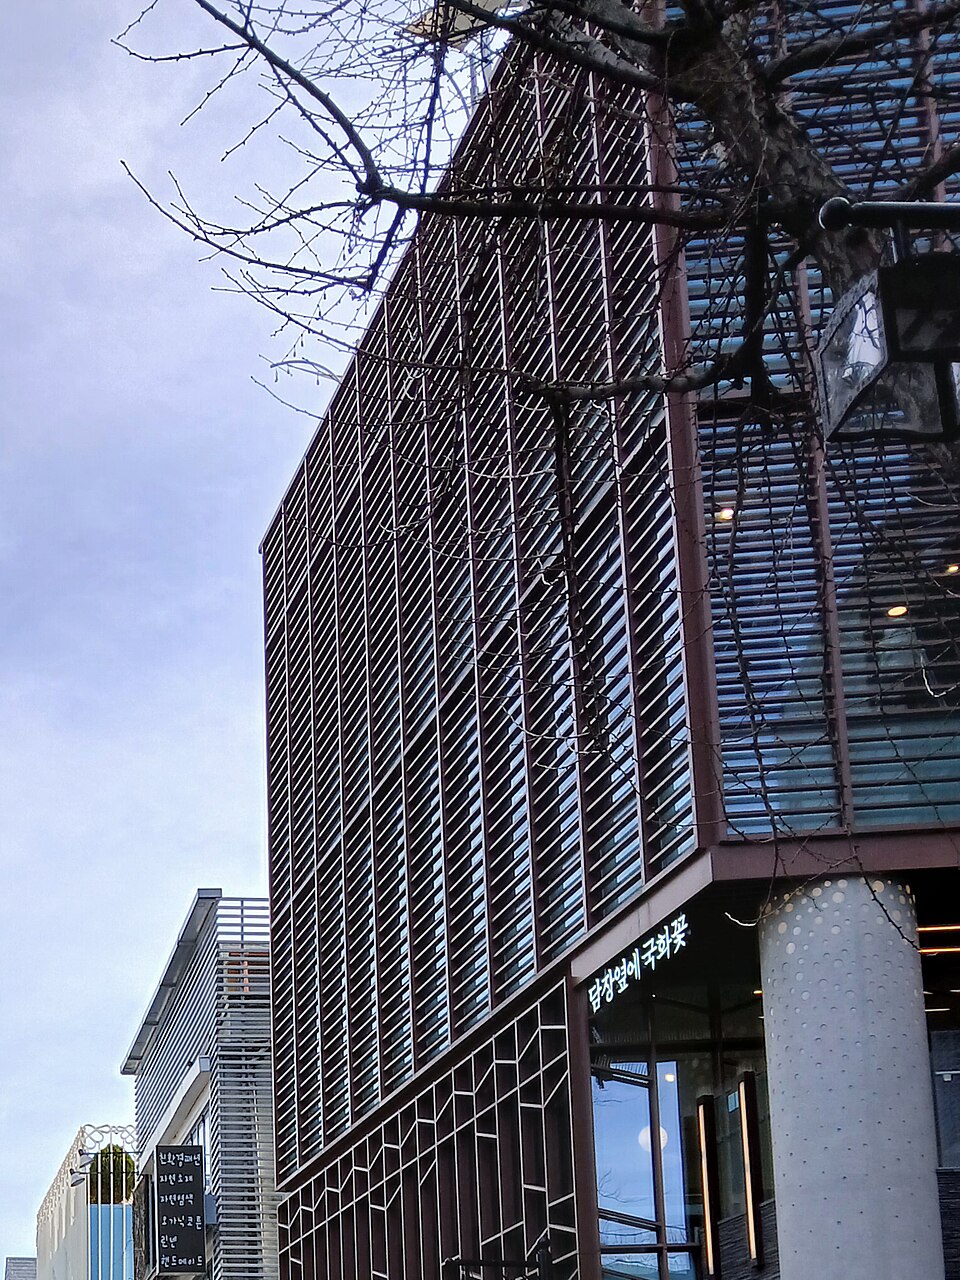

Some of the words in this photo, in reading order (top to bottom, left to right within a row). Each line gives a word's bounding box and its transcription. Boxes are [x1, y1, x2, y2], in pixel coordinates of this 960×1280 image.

[588, 948, 641, 1014] 담장옆에
[641, 914, 688, 971] 국화꽃
[160, 1254, 203, 1268] 핸드메이드
